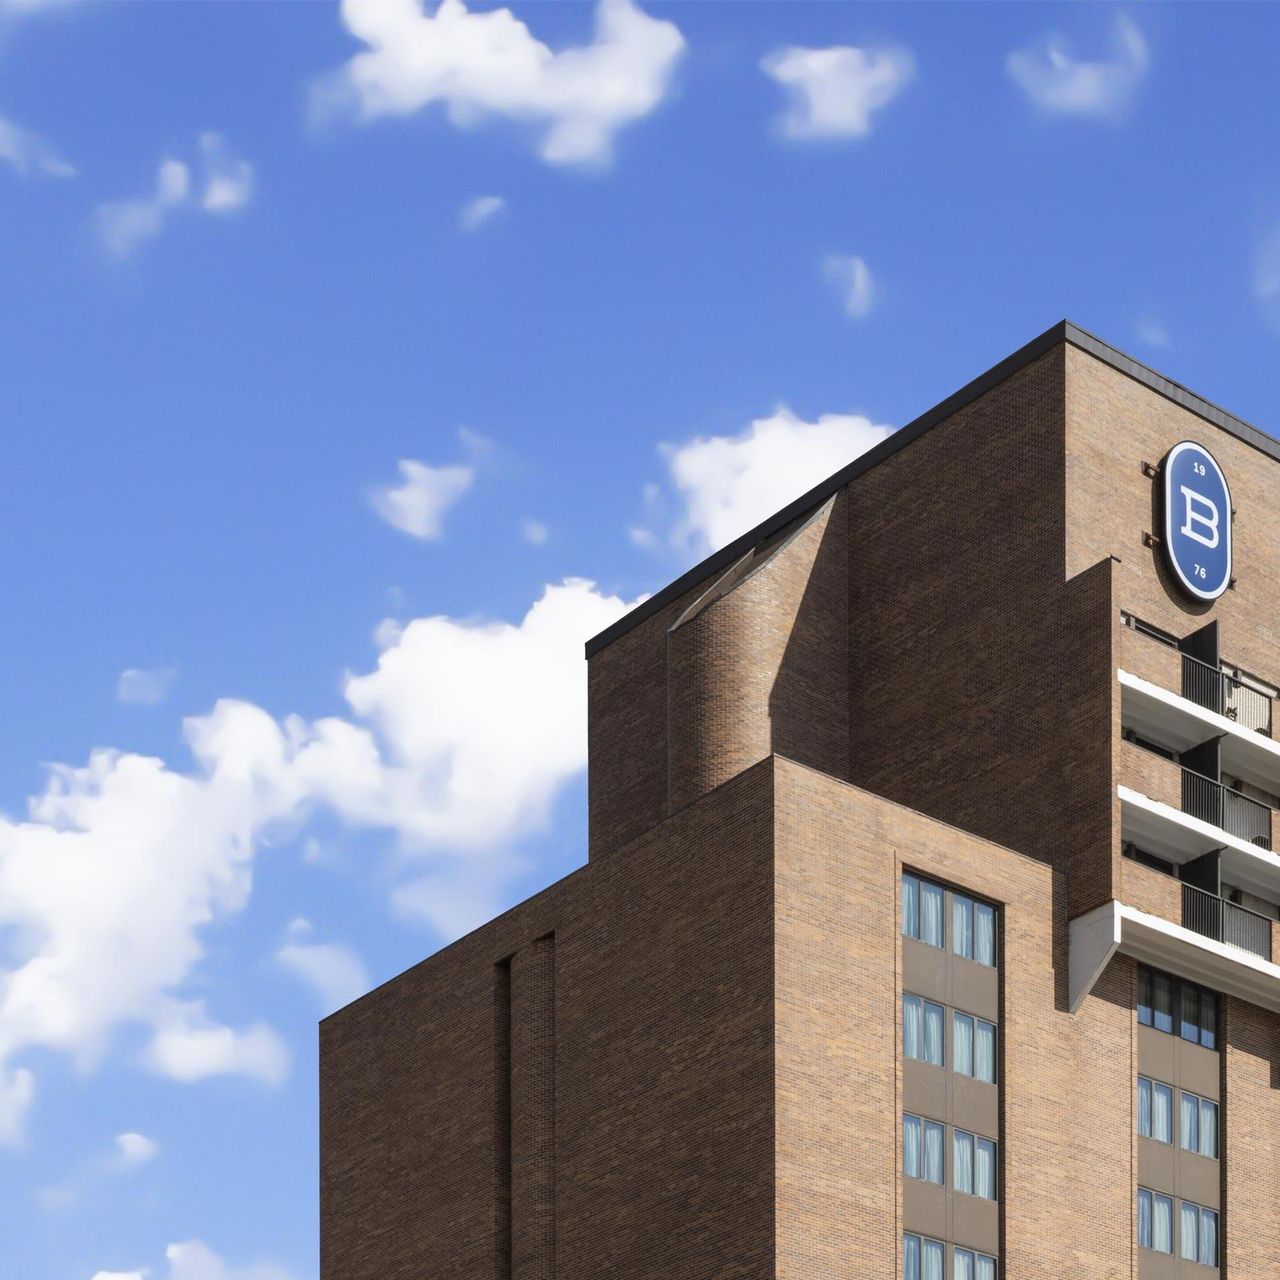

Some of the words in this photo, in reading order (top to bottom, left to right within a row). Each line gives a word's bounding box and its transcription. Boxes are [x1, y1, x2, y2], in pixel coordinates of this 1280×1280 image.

[1193, 462, 1206, 476] 19
[1180, 485, 1219, 549] B
[1194, 564, 1207, 579] 76
